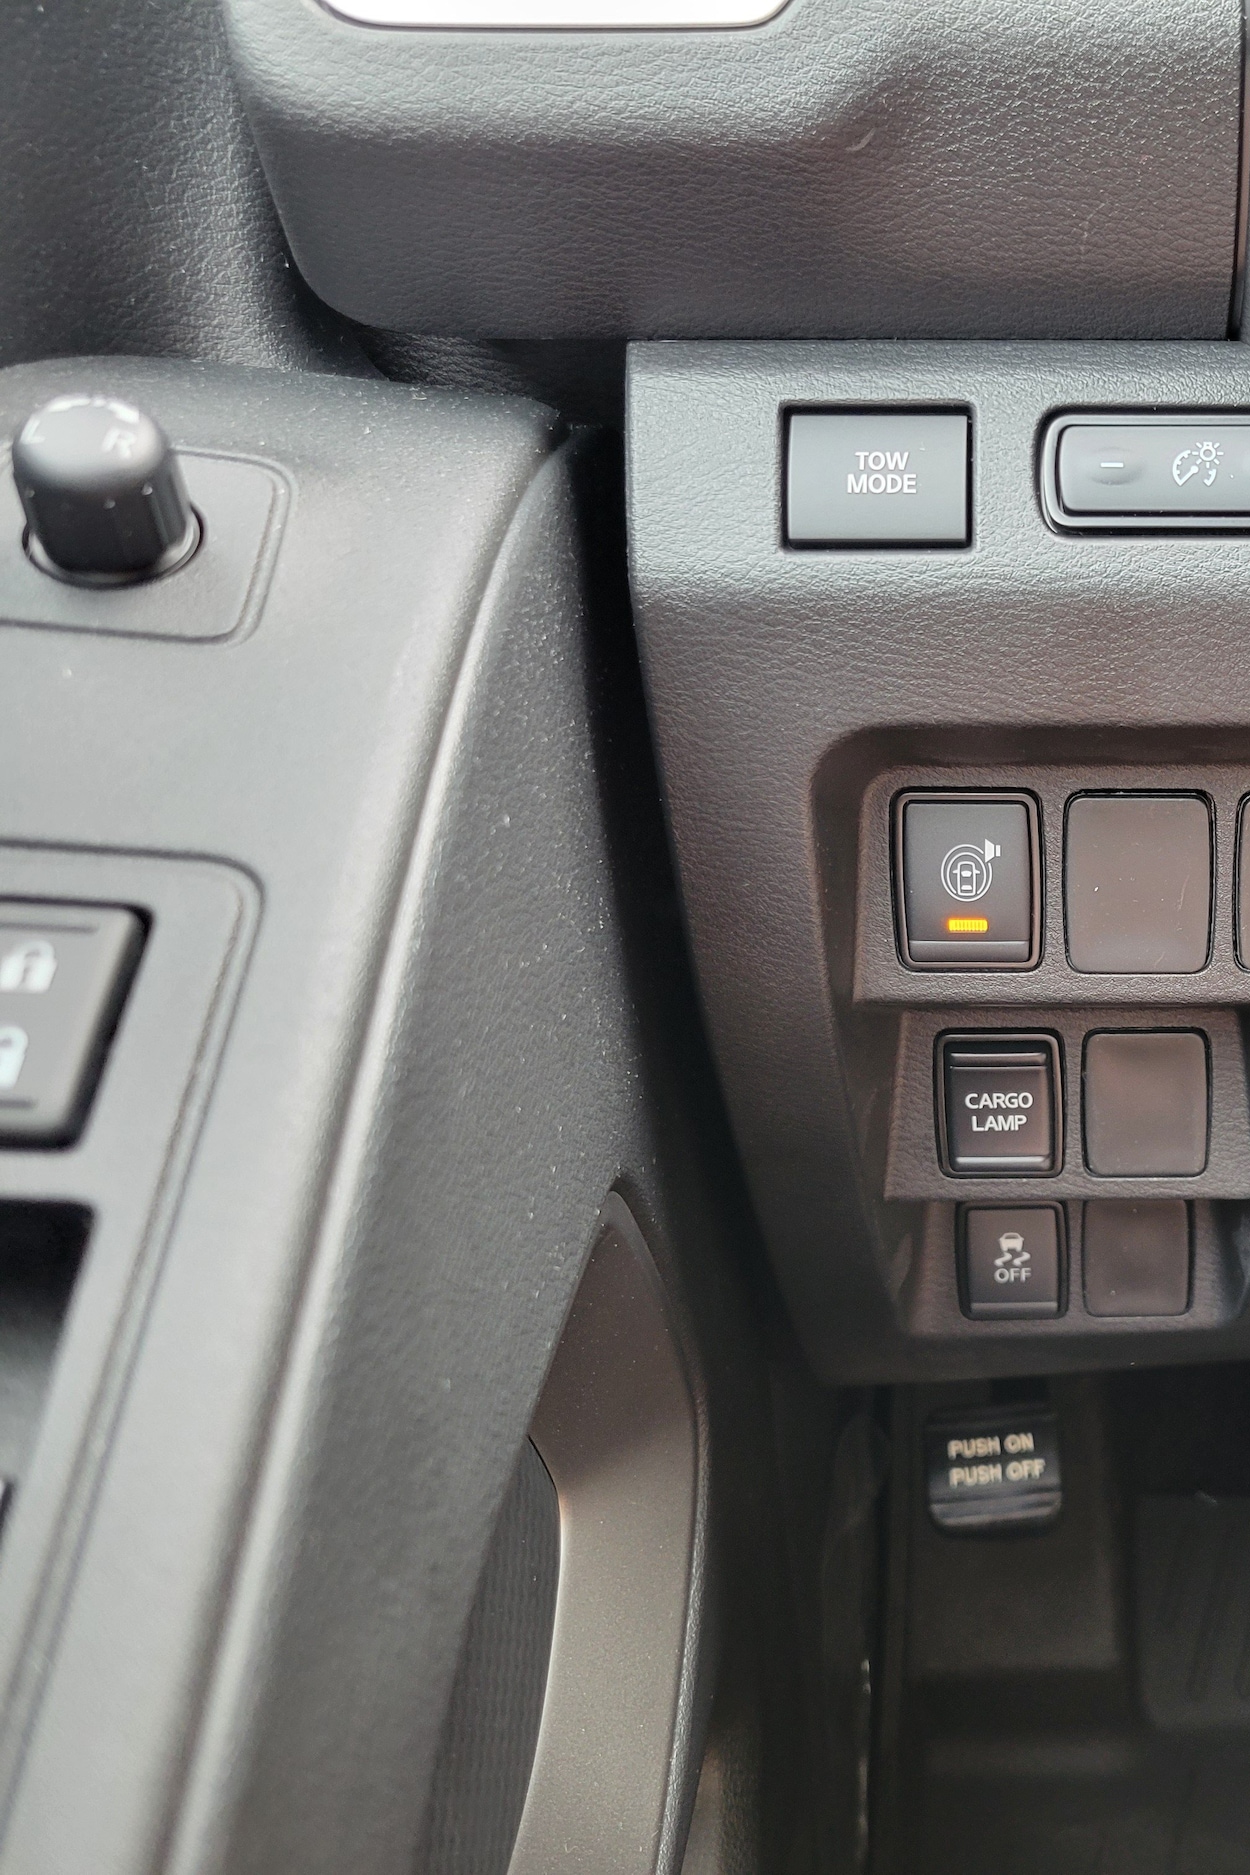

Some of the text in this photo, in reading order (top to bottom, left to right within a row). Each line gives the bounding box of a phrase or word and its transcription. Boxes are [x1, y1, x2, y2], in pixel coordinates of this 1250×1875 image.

[854, 451, 909, 471] TOW
[847, 473, 917, 494] MODE
[965, 1092, 1033, 1109] CARGO
[971, 1114, 1027, 1132] LAMP
[994, 1267, 1031, 1282] OFF
[947, 1432, 1034, 1459] PUSH ON
[949, 1458, 1045, 1488] PUSH OFF
